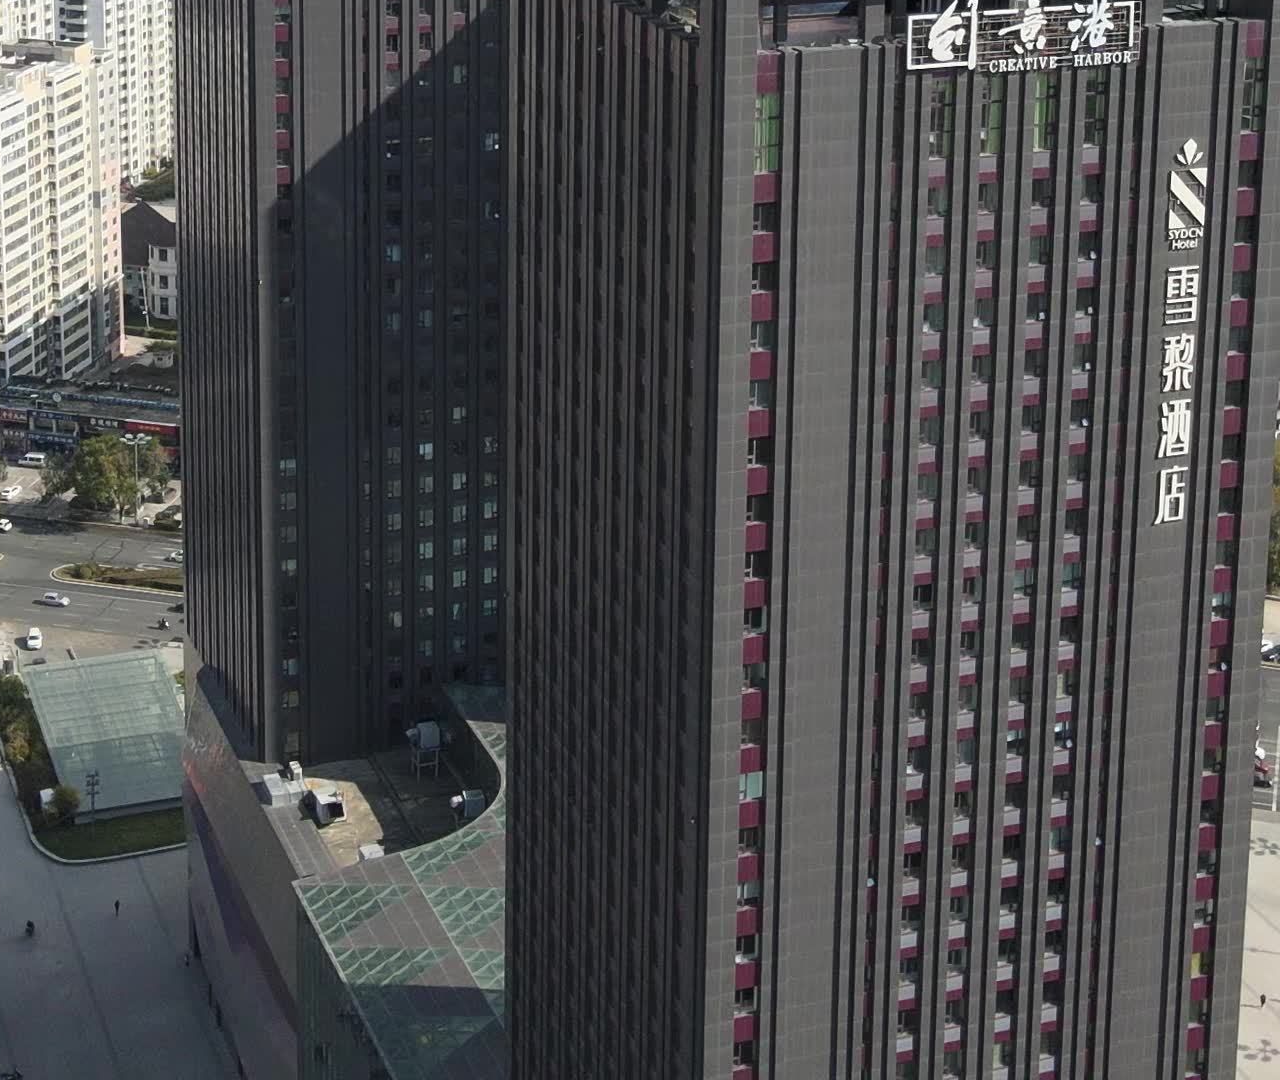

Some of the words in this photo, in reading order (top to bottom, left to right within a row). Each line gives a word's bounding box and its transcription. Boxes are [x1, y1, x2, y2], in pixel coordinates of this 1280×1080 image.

[988, 55, 1058, 74] CREATIVE
[1073, 50, 1132, 68] HARBOR
[1172, 238, 1198, 250] Hotel
[1154, 265, 1200, 526] 雪黎酒店
